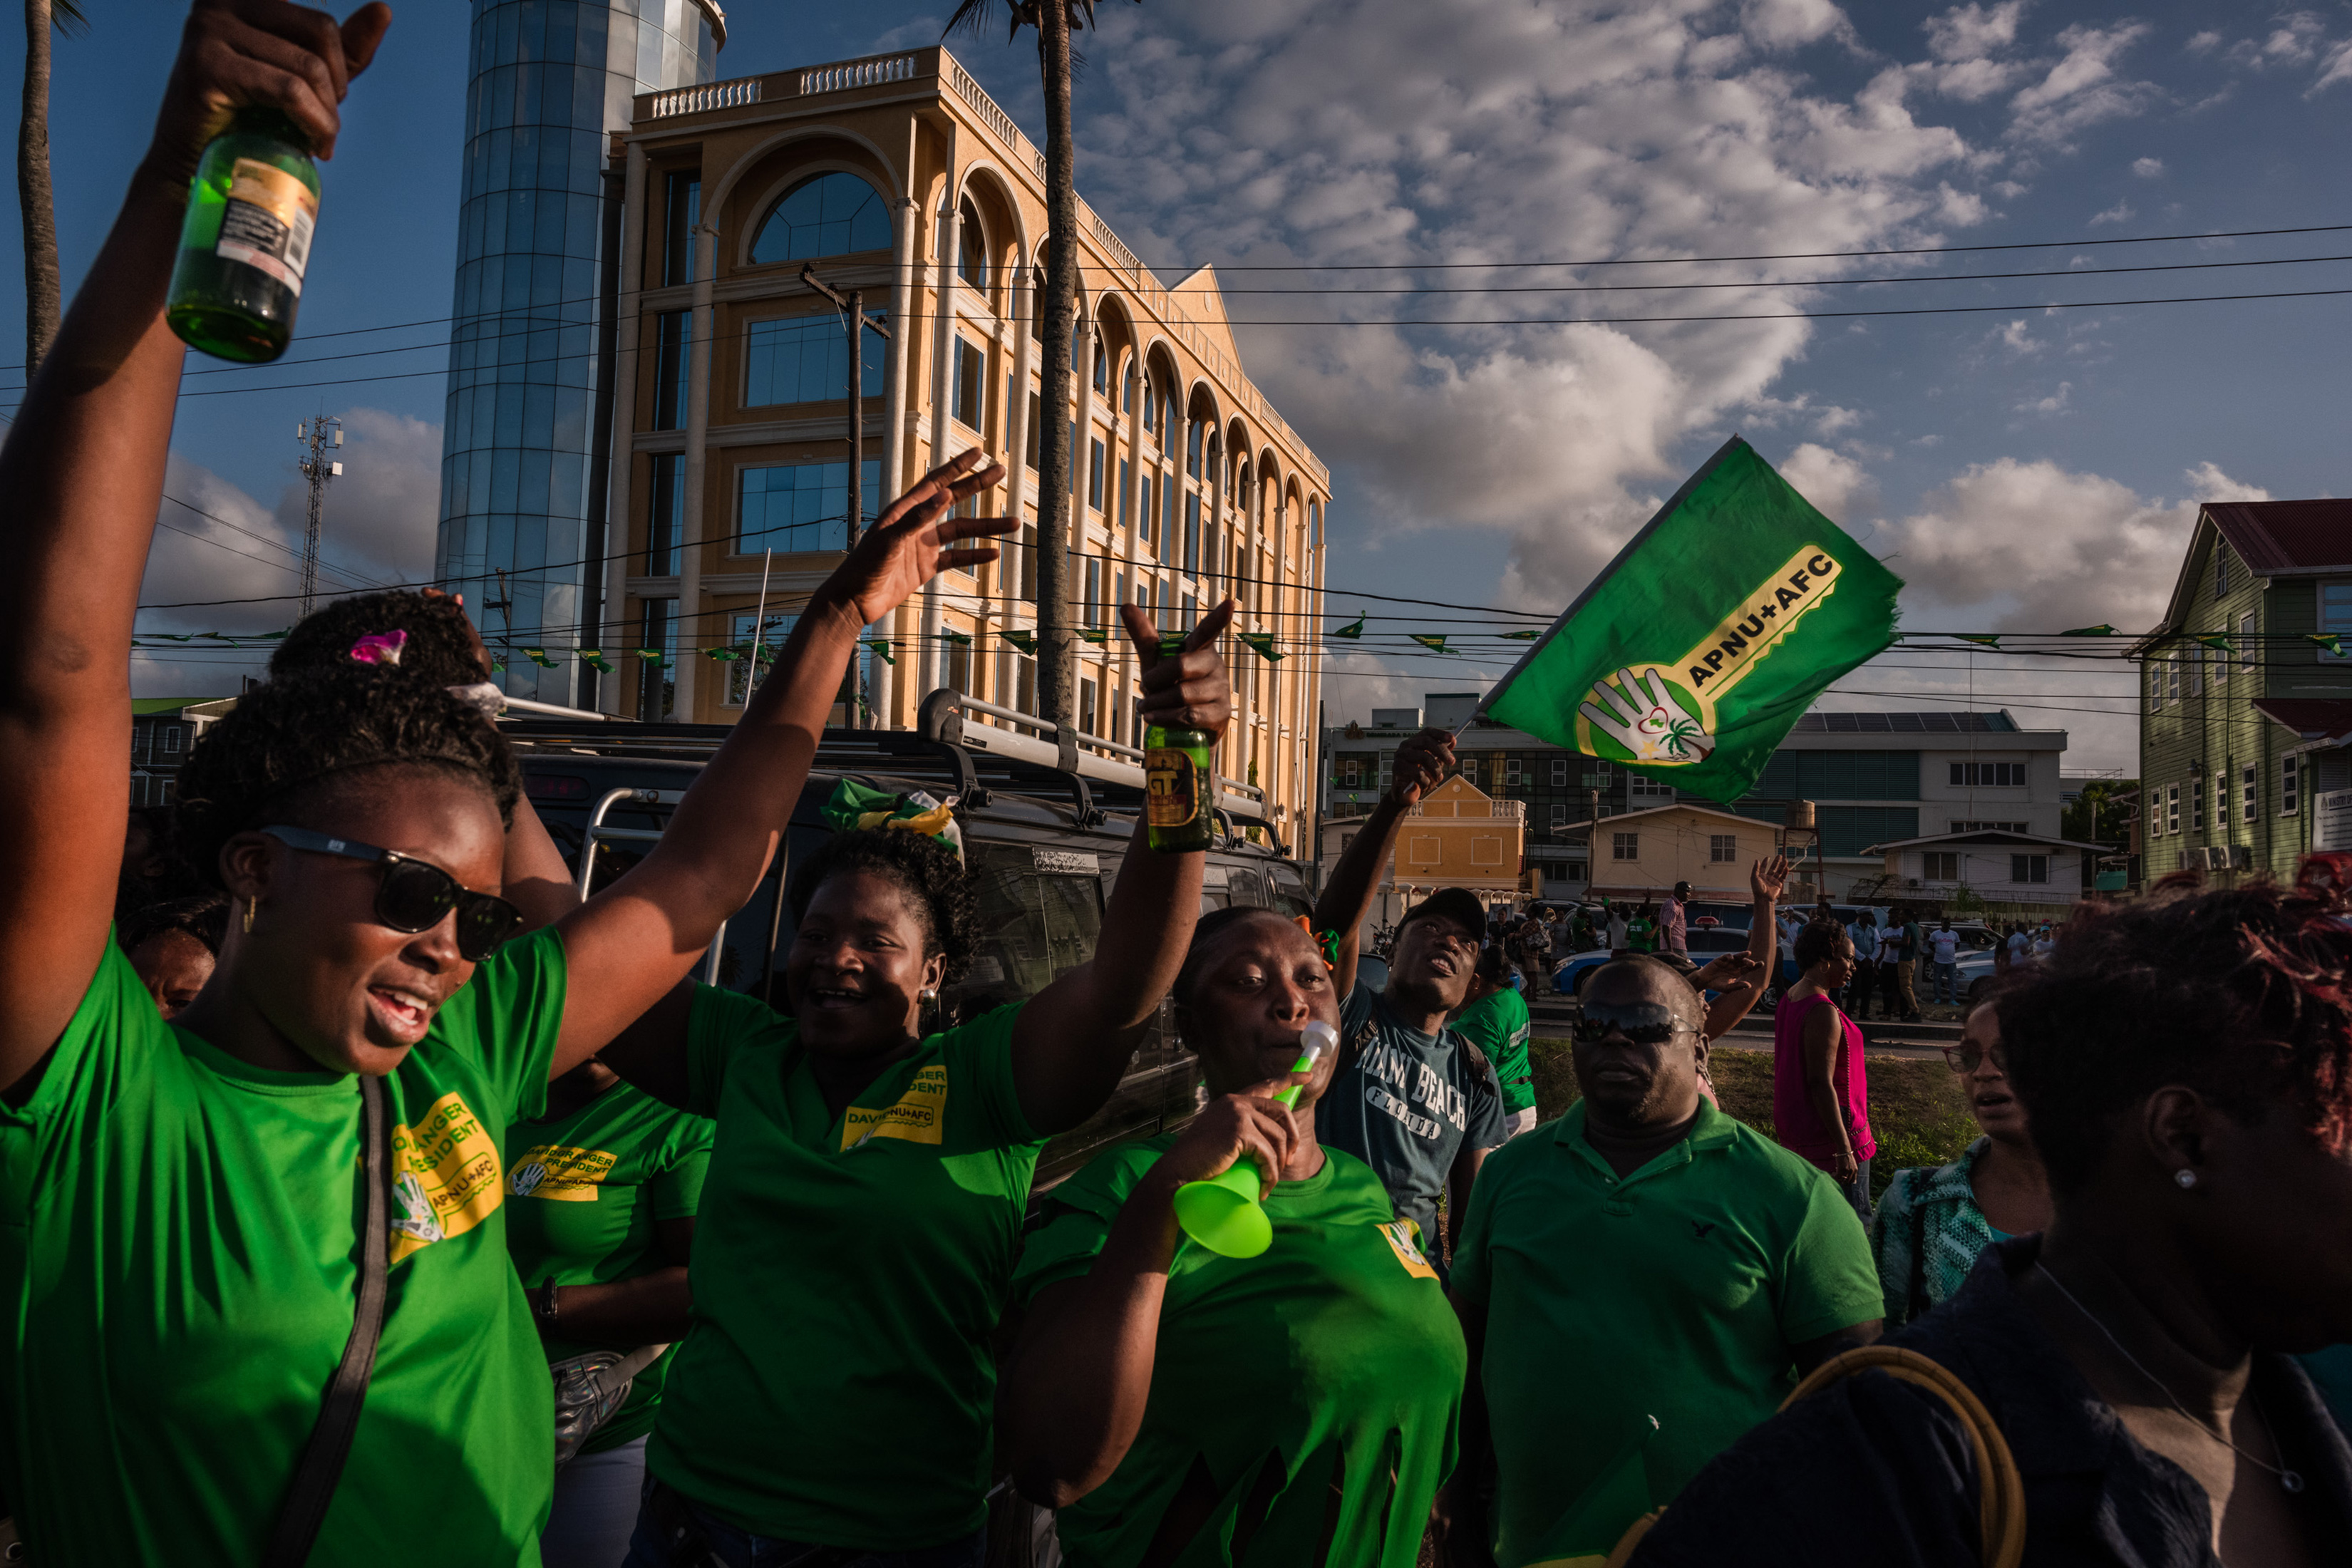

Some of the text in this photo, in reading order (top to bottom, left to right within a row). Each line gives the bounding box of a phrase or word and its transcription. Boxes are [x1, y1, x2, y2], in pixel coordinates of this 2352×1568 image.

[1689, 554, 1832, 688] APNU+AFC
[1148, 770, 1178, 795] GT
[890, 1108, 931, 1121] NU+AFC
[1410, 1062, 1466, 1132] BEACH
[545, 1158, 609, 1172] PRESIDENT
[432, 1160, 494, 1209] APNU+AFC
